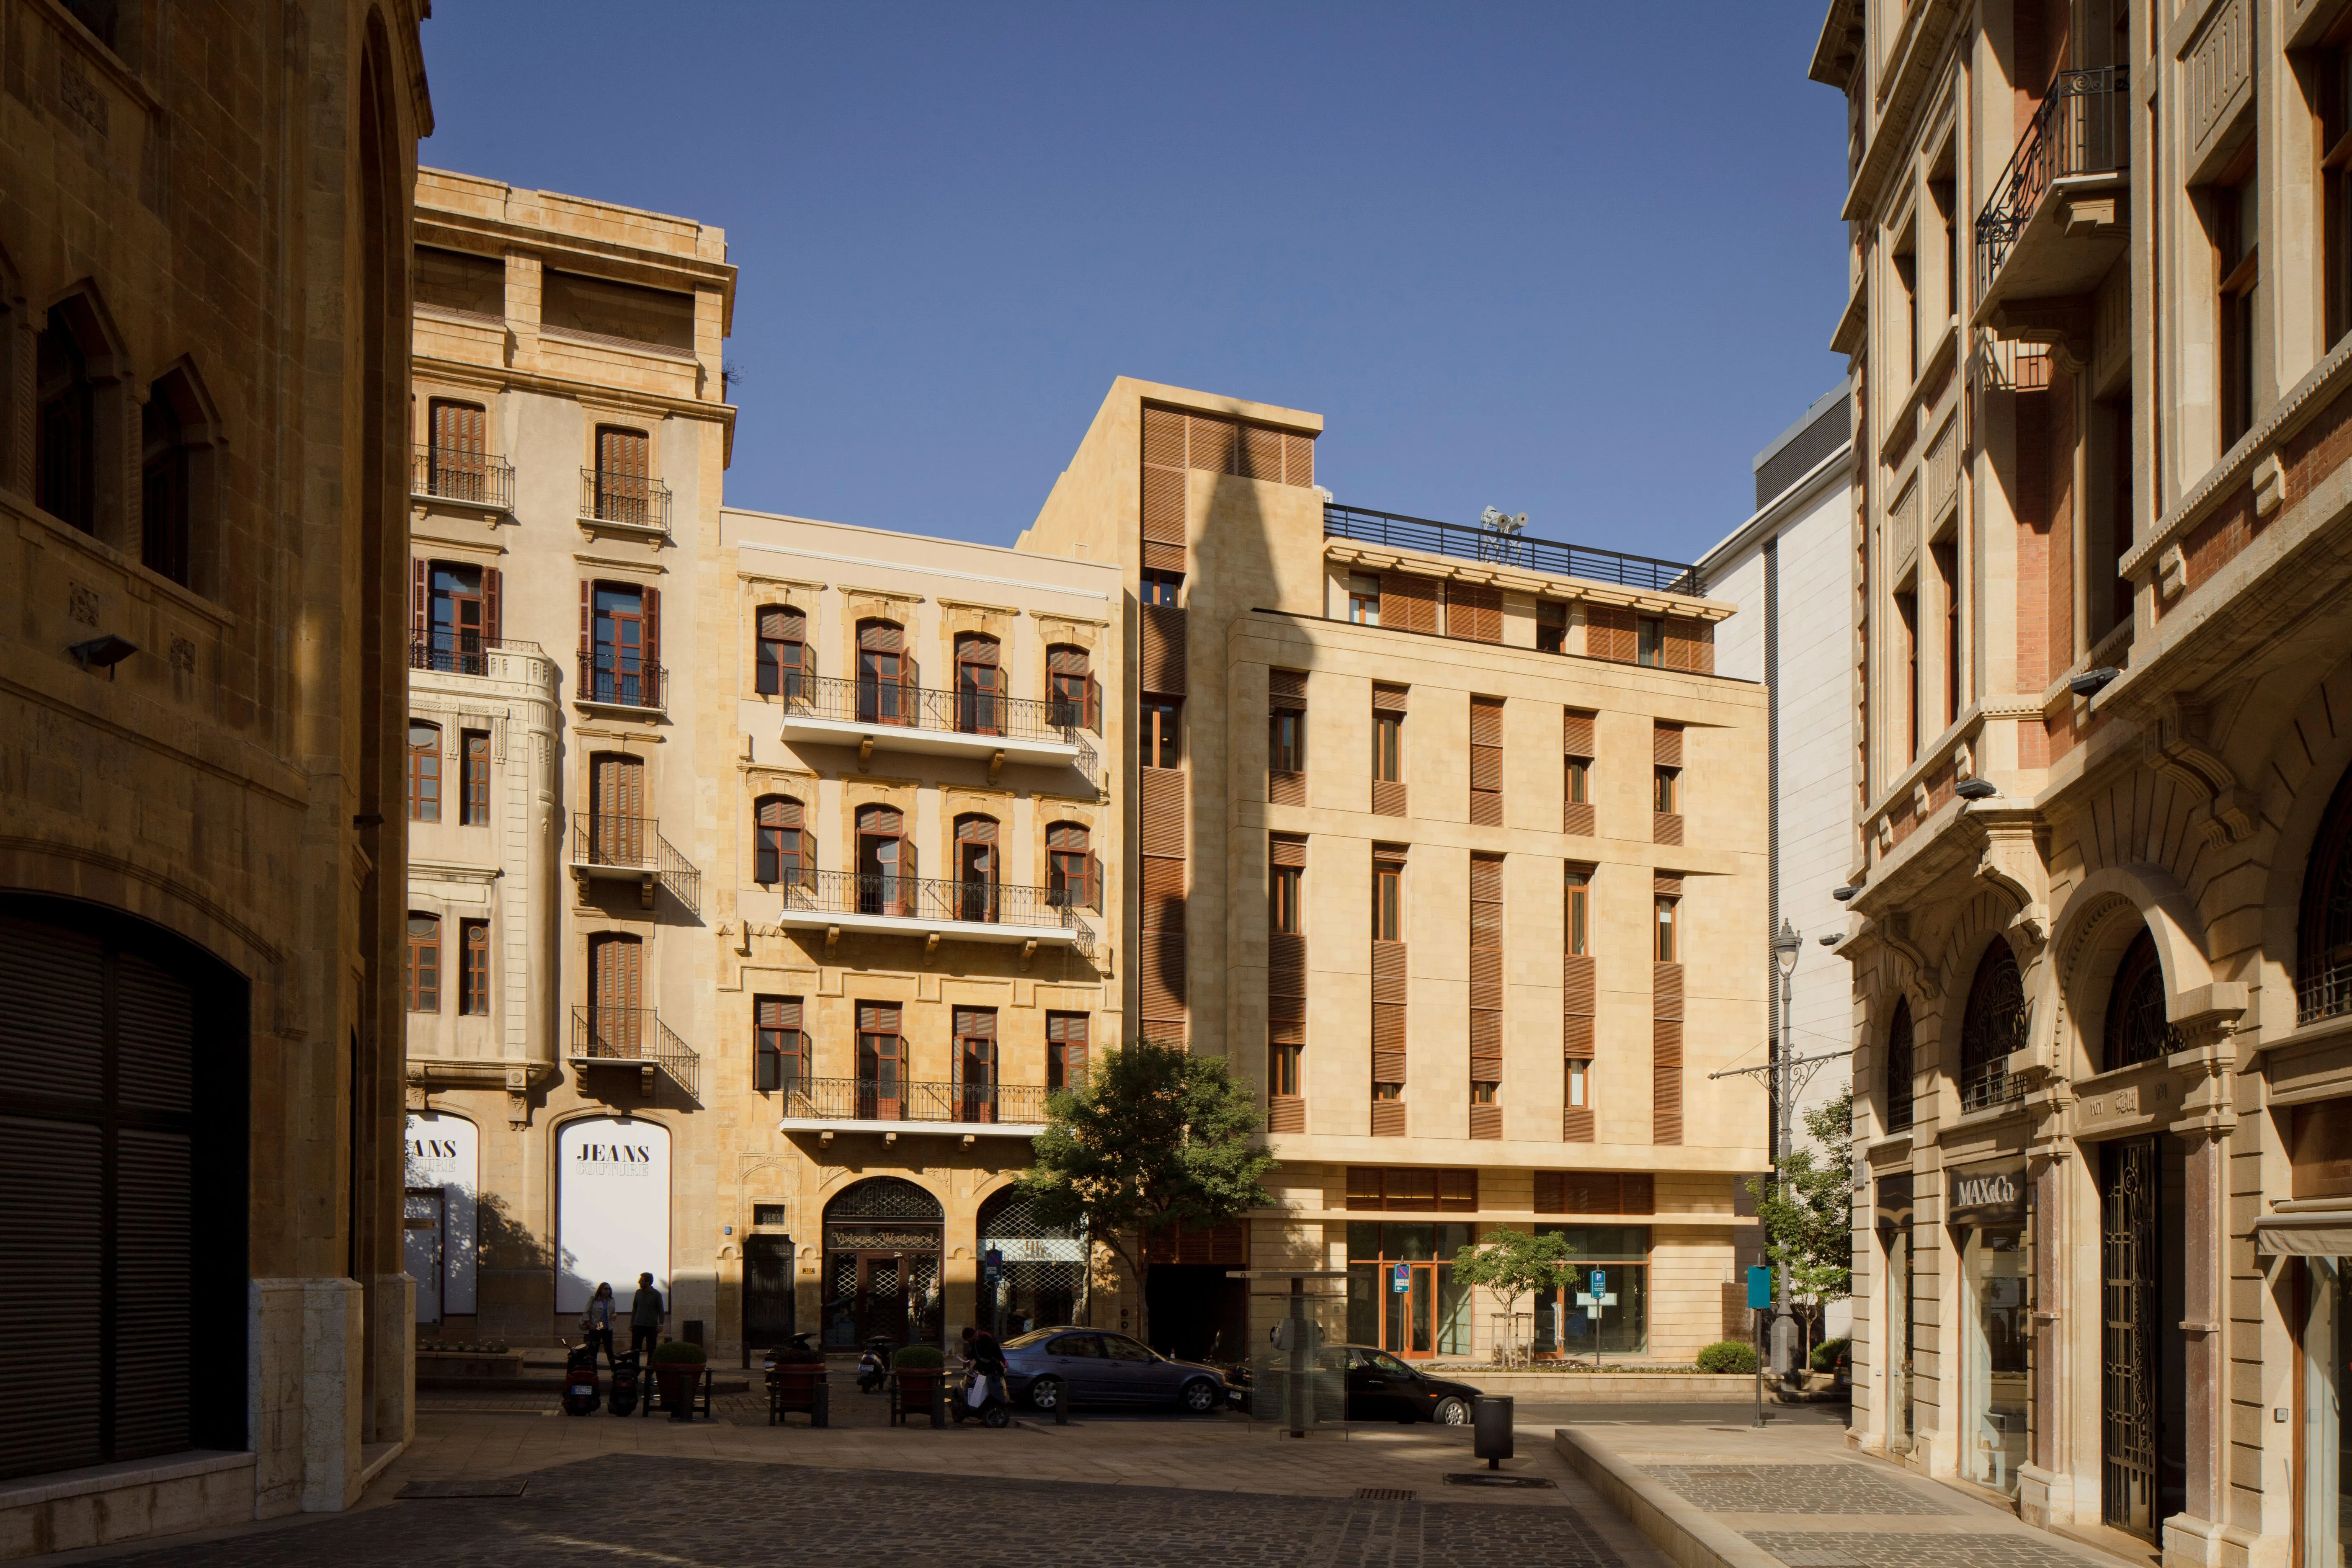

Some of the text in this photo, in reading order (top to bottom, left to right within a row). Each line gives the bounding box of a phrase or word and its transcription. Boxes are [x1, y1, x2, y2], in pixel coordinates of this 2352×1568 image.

[405, 1139, 456, 1158] ANS
[577, 1144, 649, 1163] JEANS
[576, 1162, 648, 1176] COUTURE
[832, 1232, 934, 1244] Vivienne Westwood
